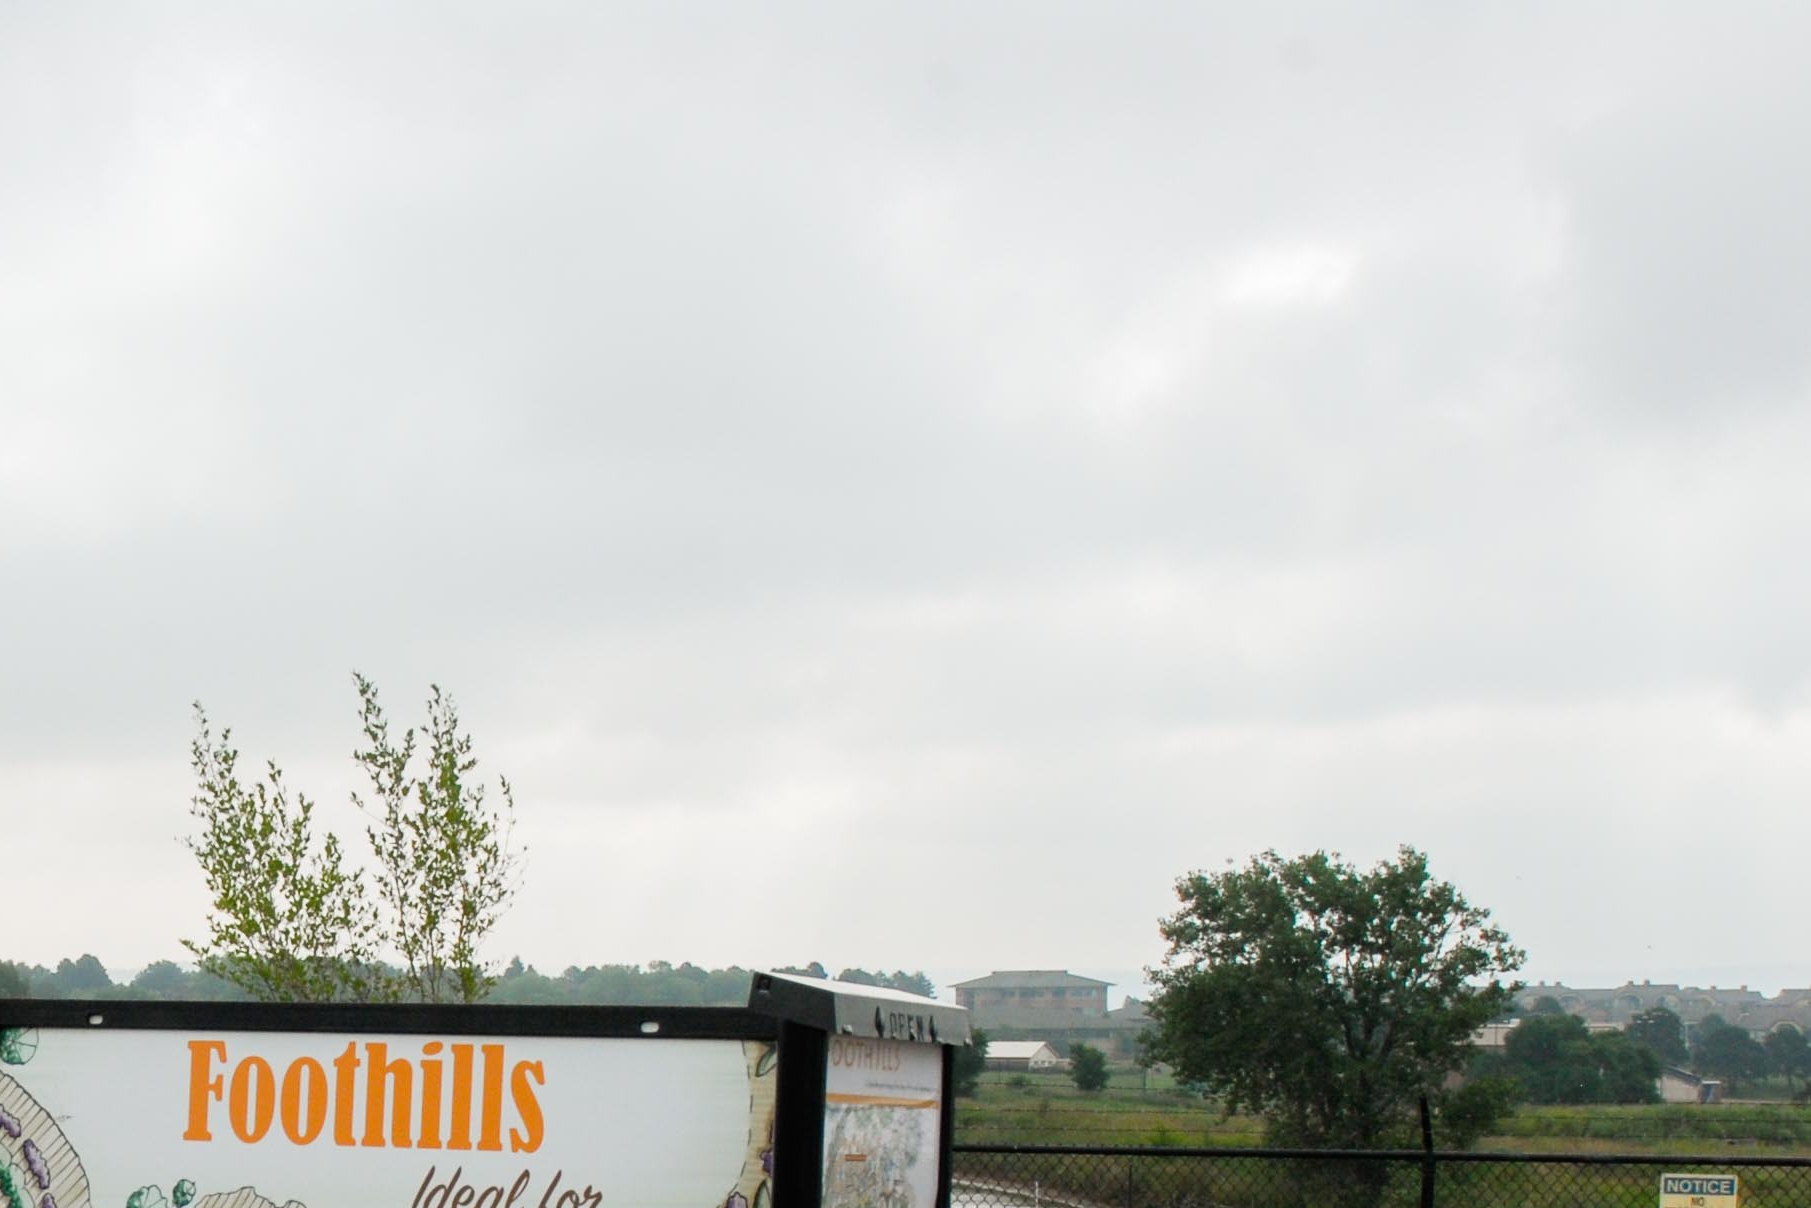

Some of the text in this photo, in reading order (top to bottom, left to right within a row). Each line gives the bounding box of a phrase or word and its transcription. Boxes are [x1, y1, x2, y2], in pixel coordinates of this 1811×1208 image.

[889, 1011, 925, 1041] OPEN
[831, 1039, 901, 1072] OOTHILLS
[183, 1039, 546, 1154] Foothills
[1666, 1178, 1732, 1194] NOTICE
